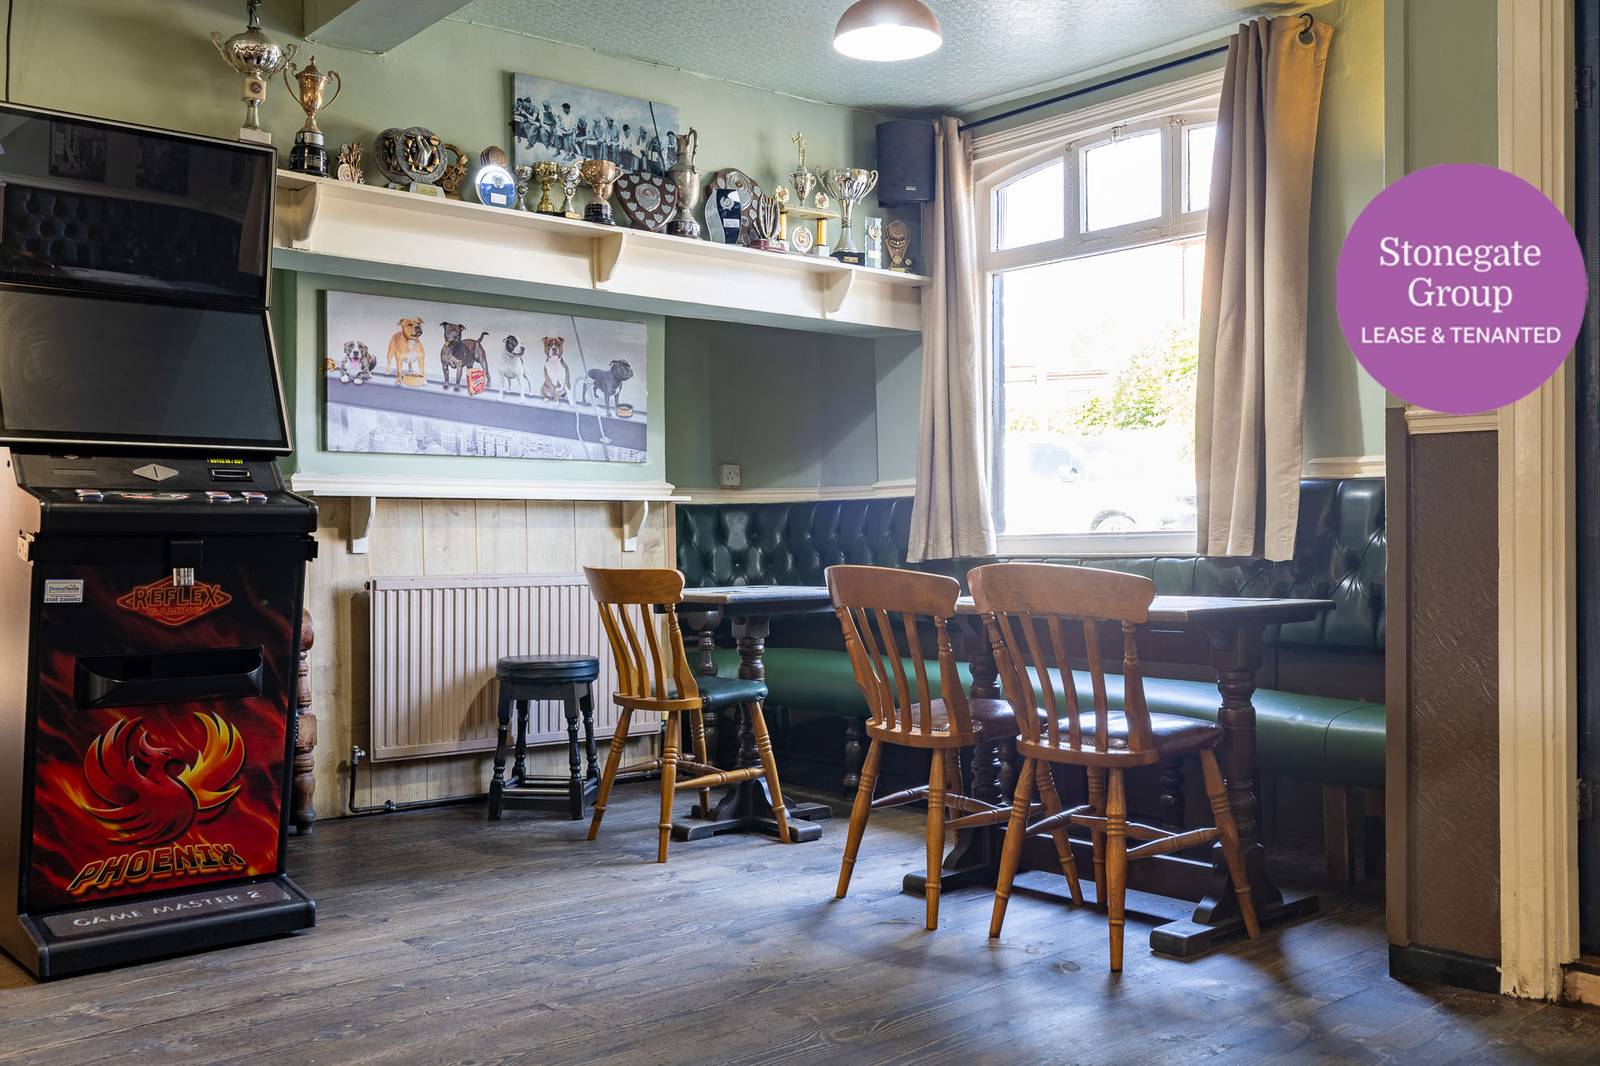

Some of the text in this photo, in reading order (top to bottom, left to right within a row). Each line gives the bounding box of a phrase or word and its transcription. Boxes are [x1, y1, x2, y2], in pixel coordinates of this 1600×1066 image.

[133, 584, 221, 609] REFLEX
[66, 843, 247, 893] PHOENIX
[73, 891, 265, 927] GAME MASTER 2
